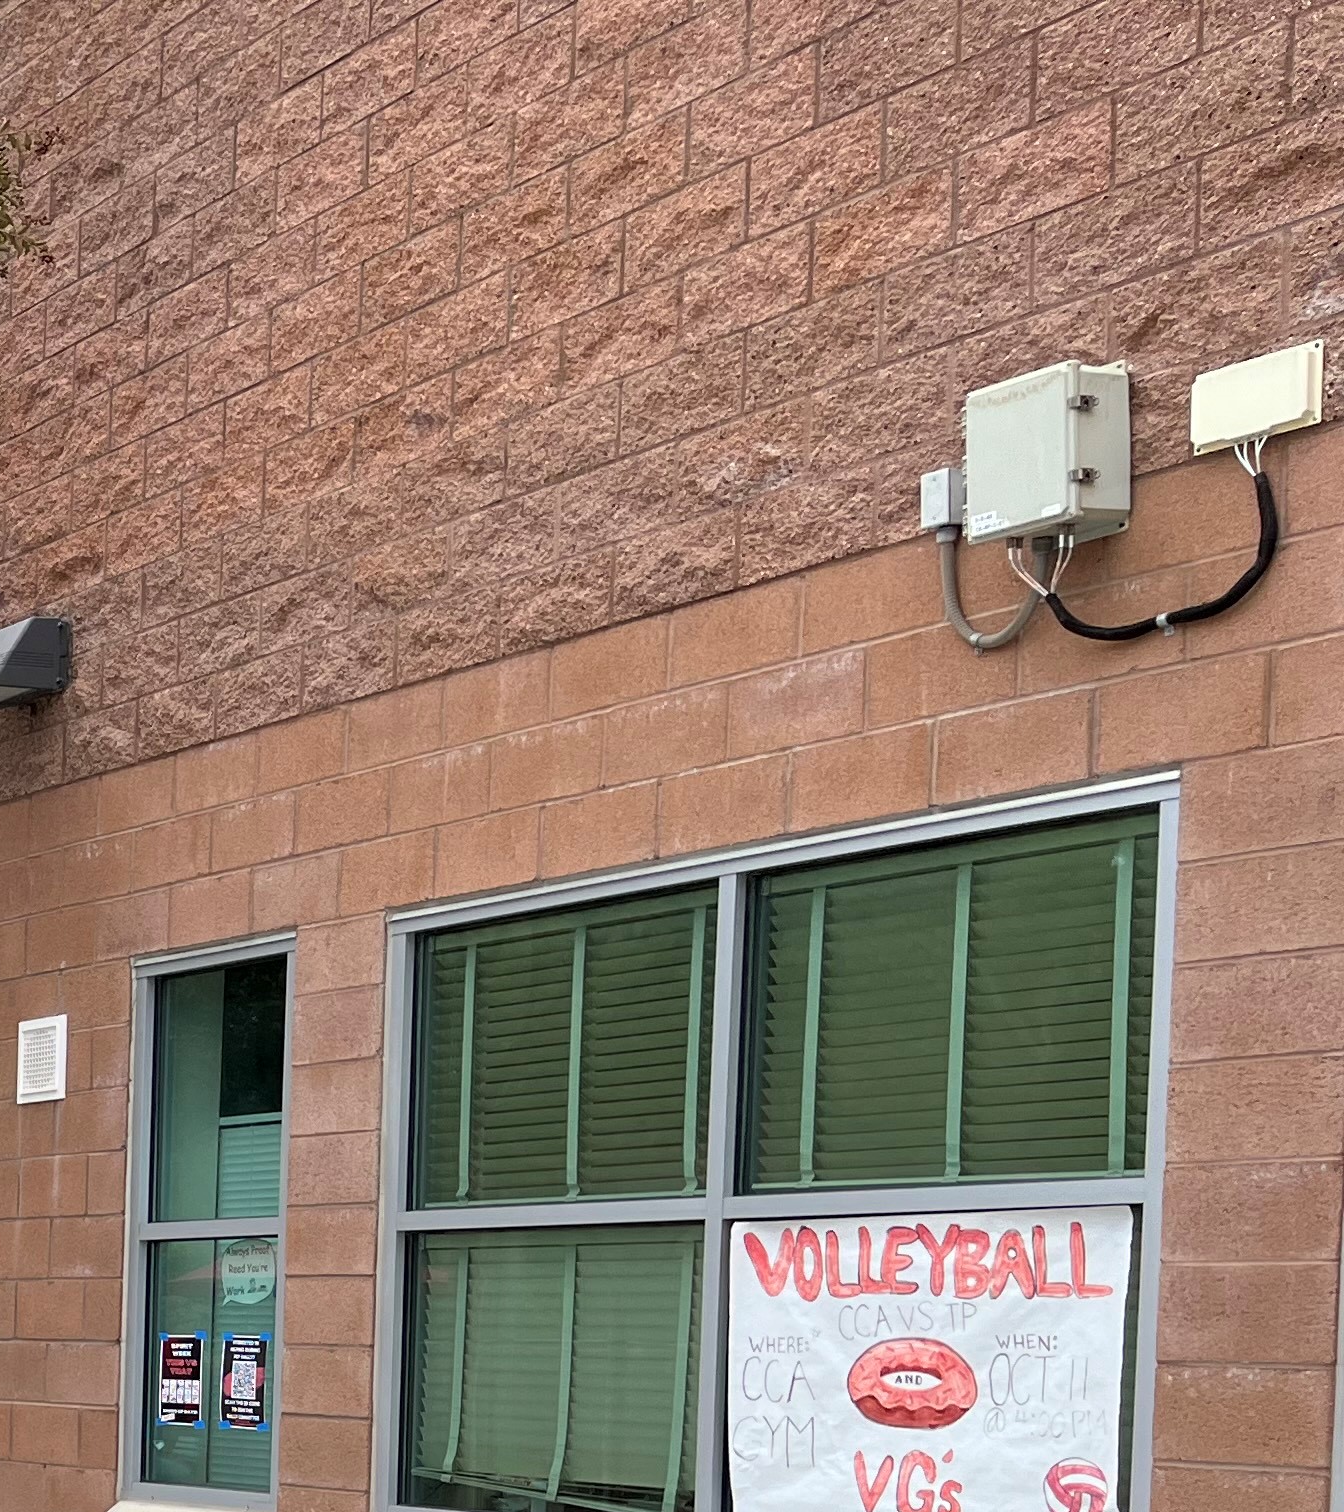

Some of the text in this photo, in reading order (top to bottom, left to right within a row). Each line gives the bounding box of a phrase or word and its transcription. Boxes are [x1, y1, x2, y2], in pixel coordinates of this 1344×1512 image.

[743, 1221, 1113, 1301] VOLLEYBALL
[838, 1301, 977, 1341] CCA VS TP
[748, 1336, 810, 1354] WHERE:
[995, 1333, 1058, 1352] WHEN:
[742, 1356, 815, 1404] CCA
[894, 1375, 923, 1386] AND
[989, 1353, 1057, 1406] OCT
